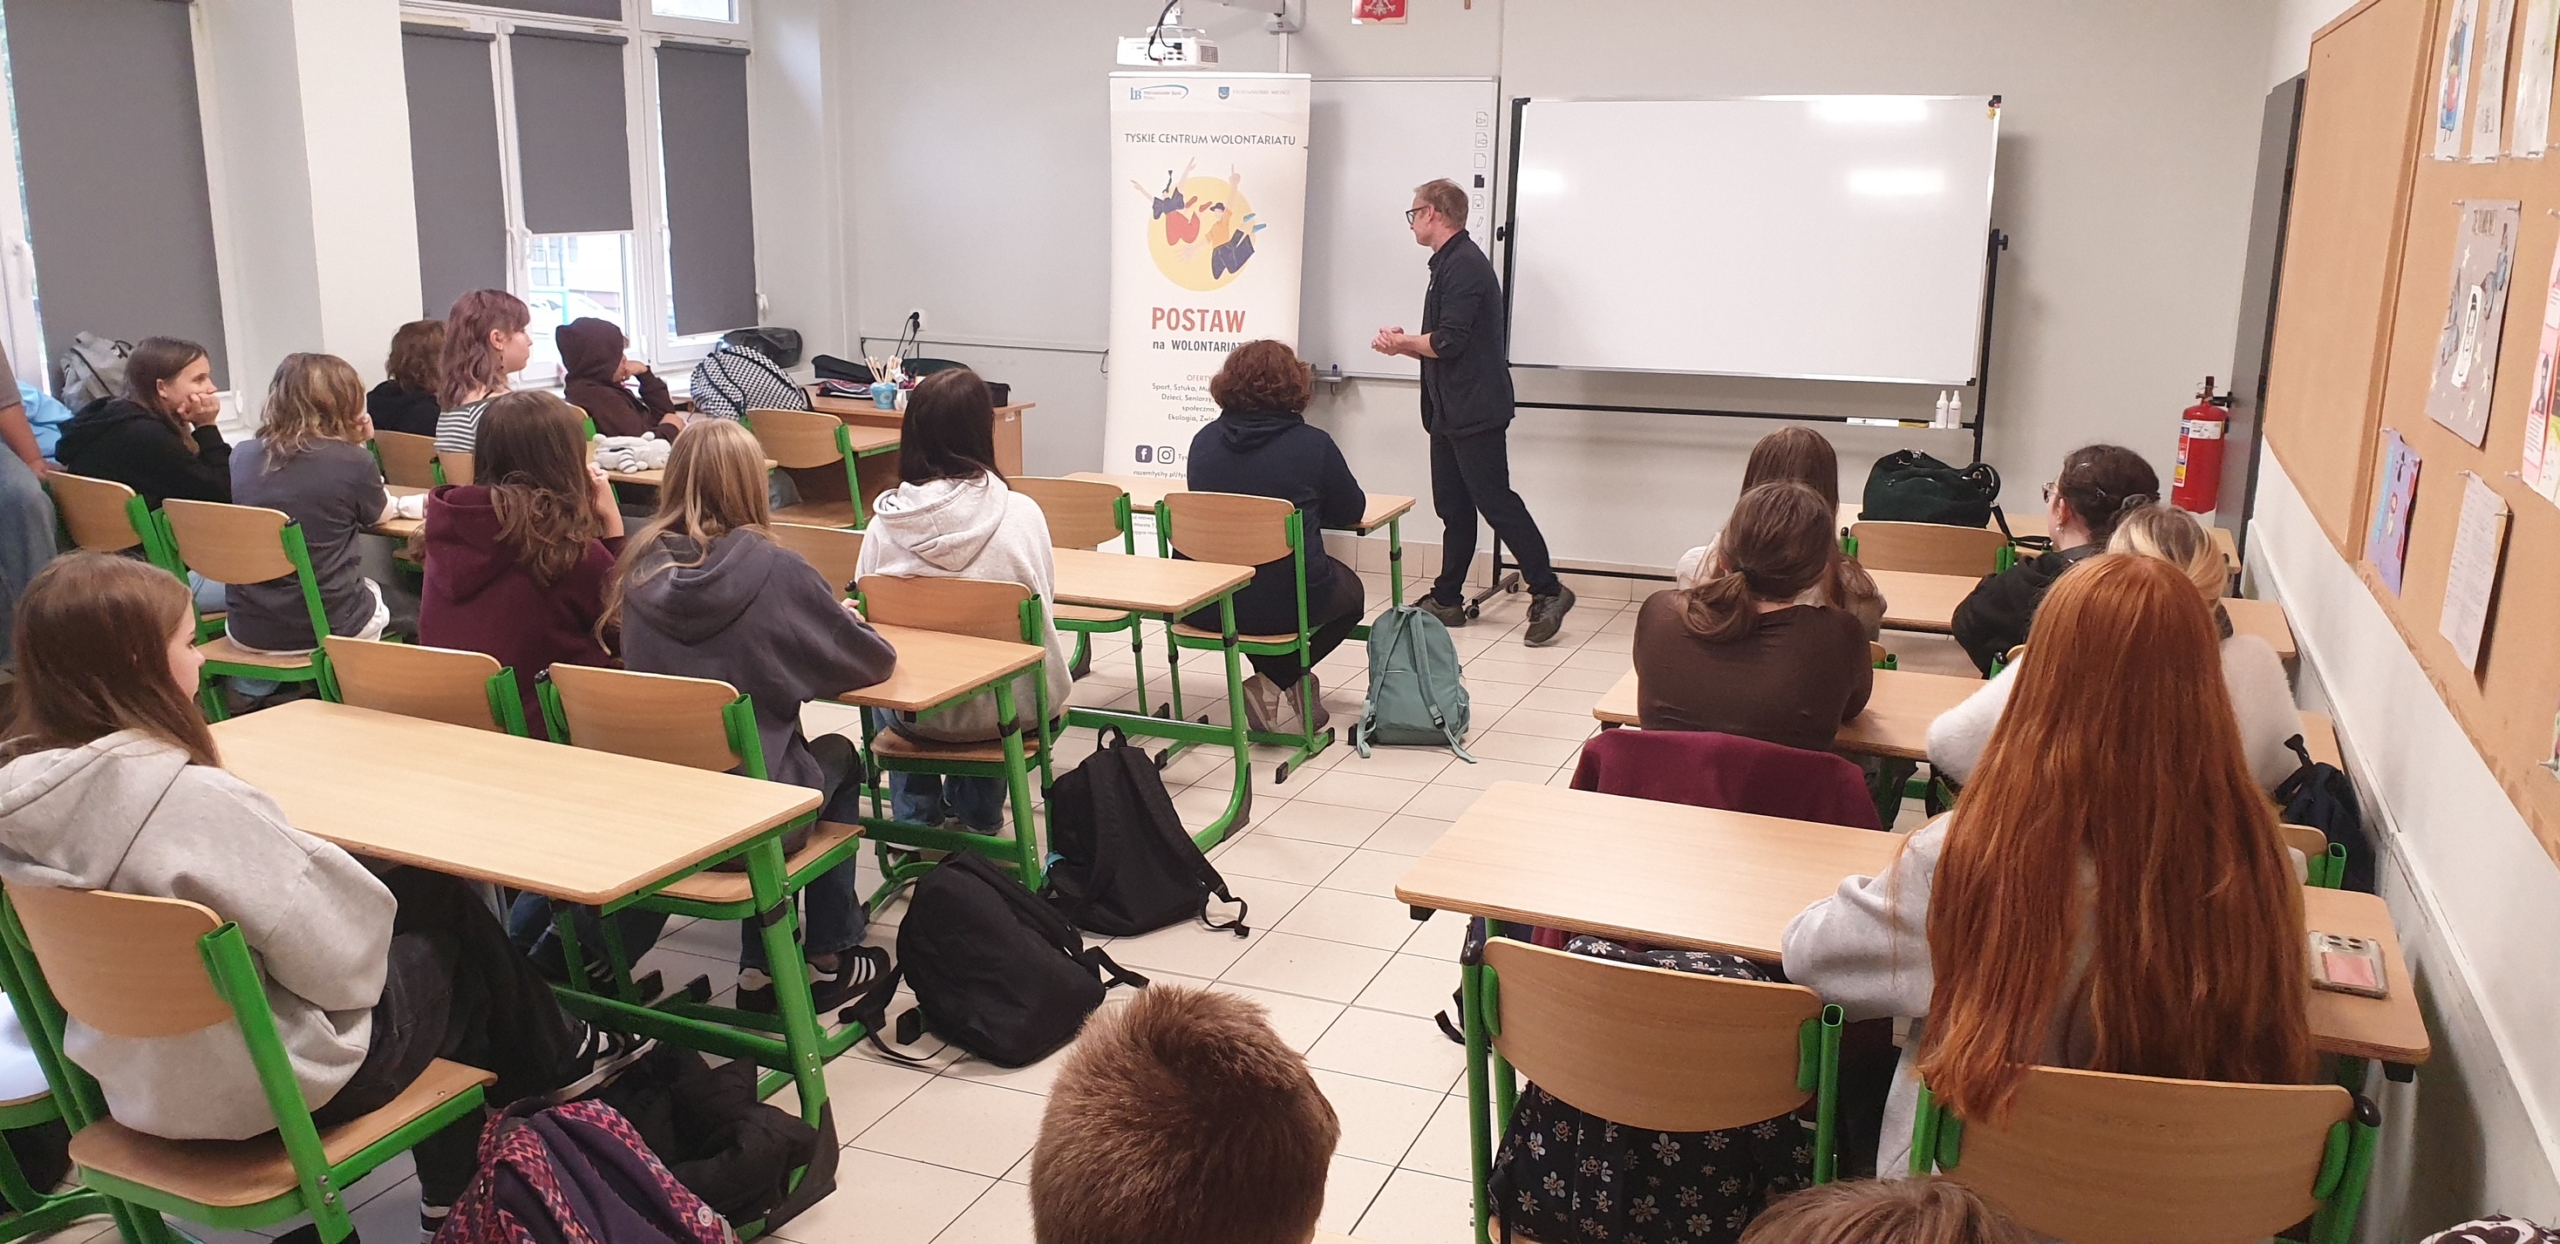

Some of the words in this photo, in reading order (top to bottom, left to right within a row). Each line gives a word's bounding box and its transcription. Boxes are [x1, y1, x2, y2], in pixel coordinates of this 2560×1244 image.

[1125, 133, 1156, 143] TYSKIE
[1158, 133, 1208, 144] CENTRUM
[1210, 134, 1296, 146] WOLONTARIATU
[1151, 306, 1246, 333] POSTAW
[1152, 341, 1165, 350] na
[1171, 340, 1241, 353] WOLONTARIA
